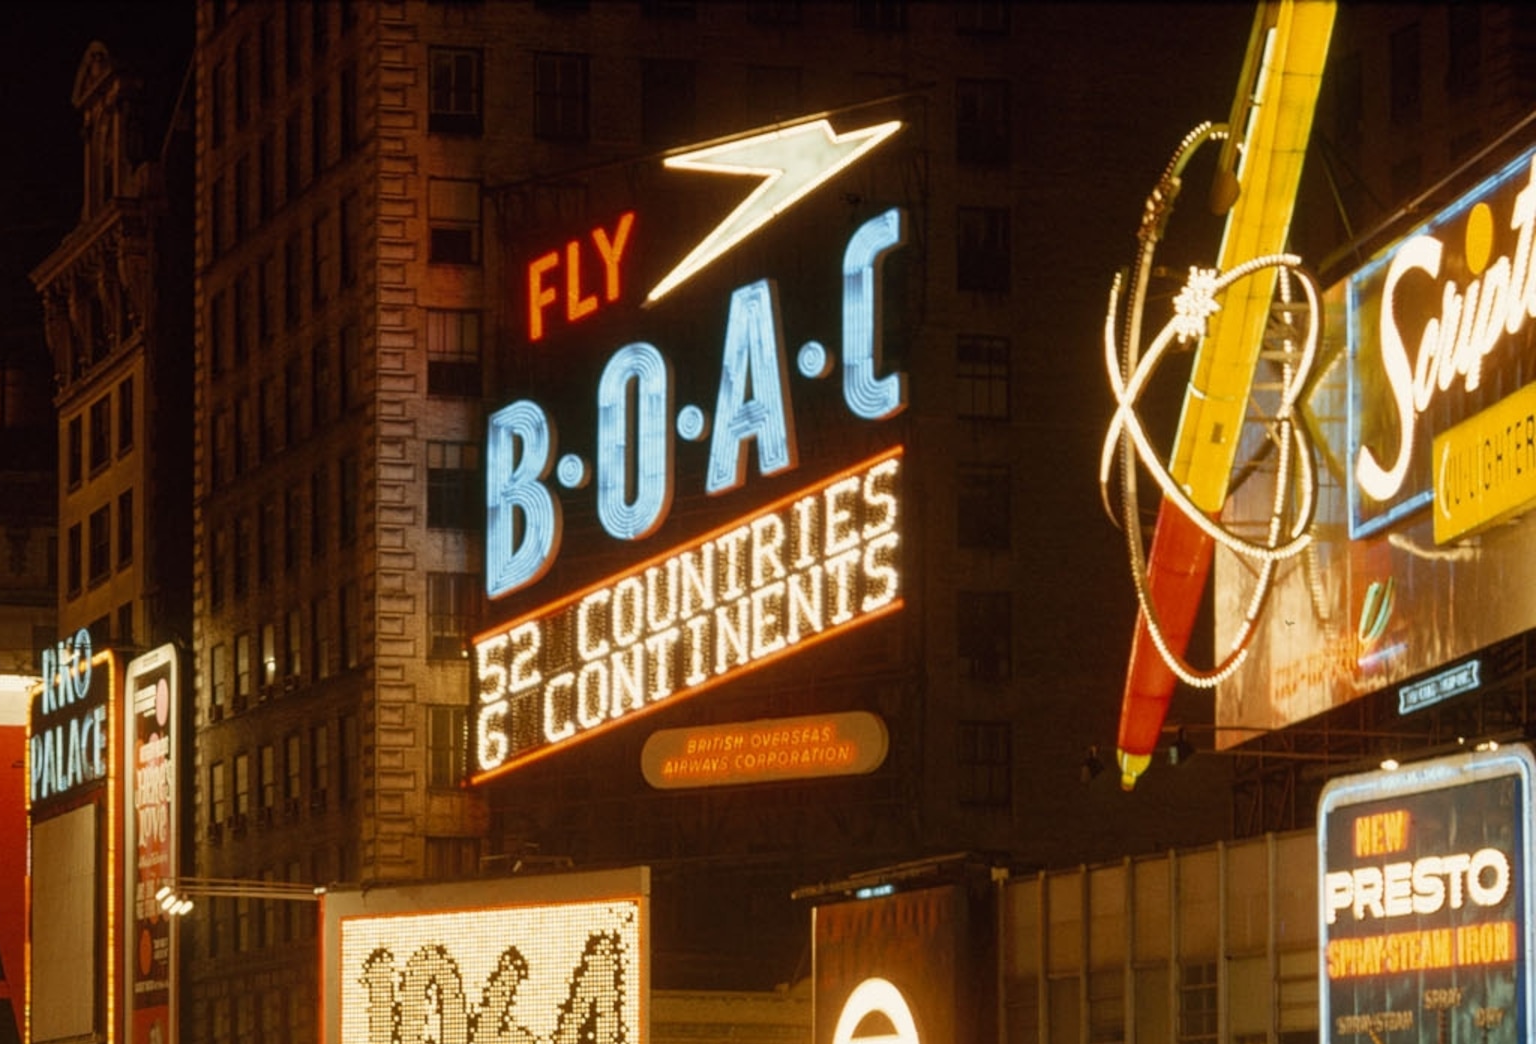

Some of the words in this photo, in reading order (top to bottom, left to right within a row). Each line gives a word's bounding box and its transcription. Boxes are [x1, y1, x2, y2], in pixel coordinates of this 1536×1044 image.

[528, 211, 635, 342] FLY
[474, 620, 543, 703] 52
[576, 457, 900, 662] COUNTRIES
[41, 627, 92, 716] RKO
[476, 702, 510, 771] 6
[541, 531, 900, 744] CONTINENTS
[30, 704, 107, 801] PALACE
[663, 754, 728, 775] AIRWAYS
[734, 745, 850, 770] CORPORATION
[686, 734, 744, 755] BRITISH
[750, 725, 831, 749] OVERSEAS
[1355, 809, 1410, 858] NEW
[1325, 847, 1511, 926] PRESTO
[1456, 920, 1511, 966] IRON
